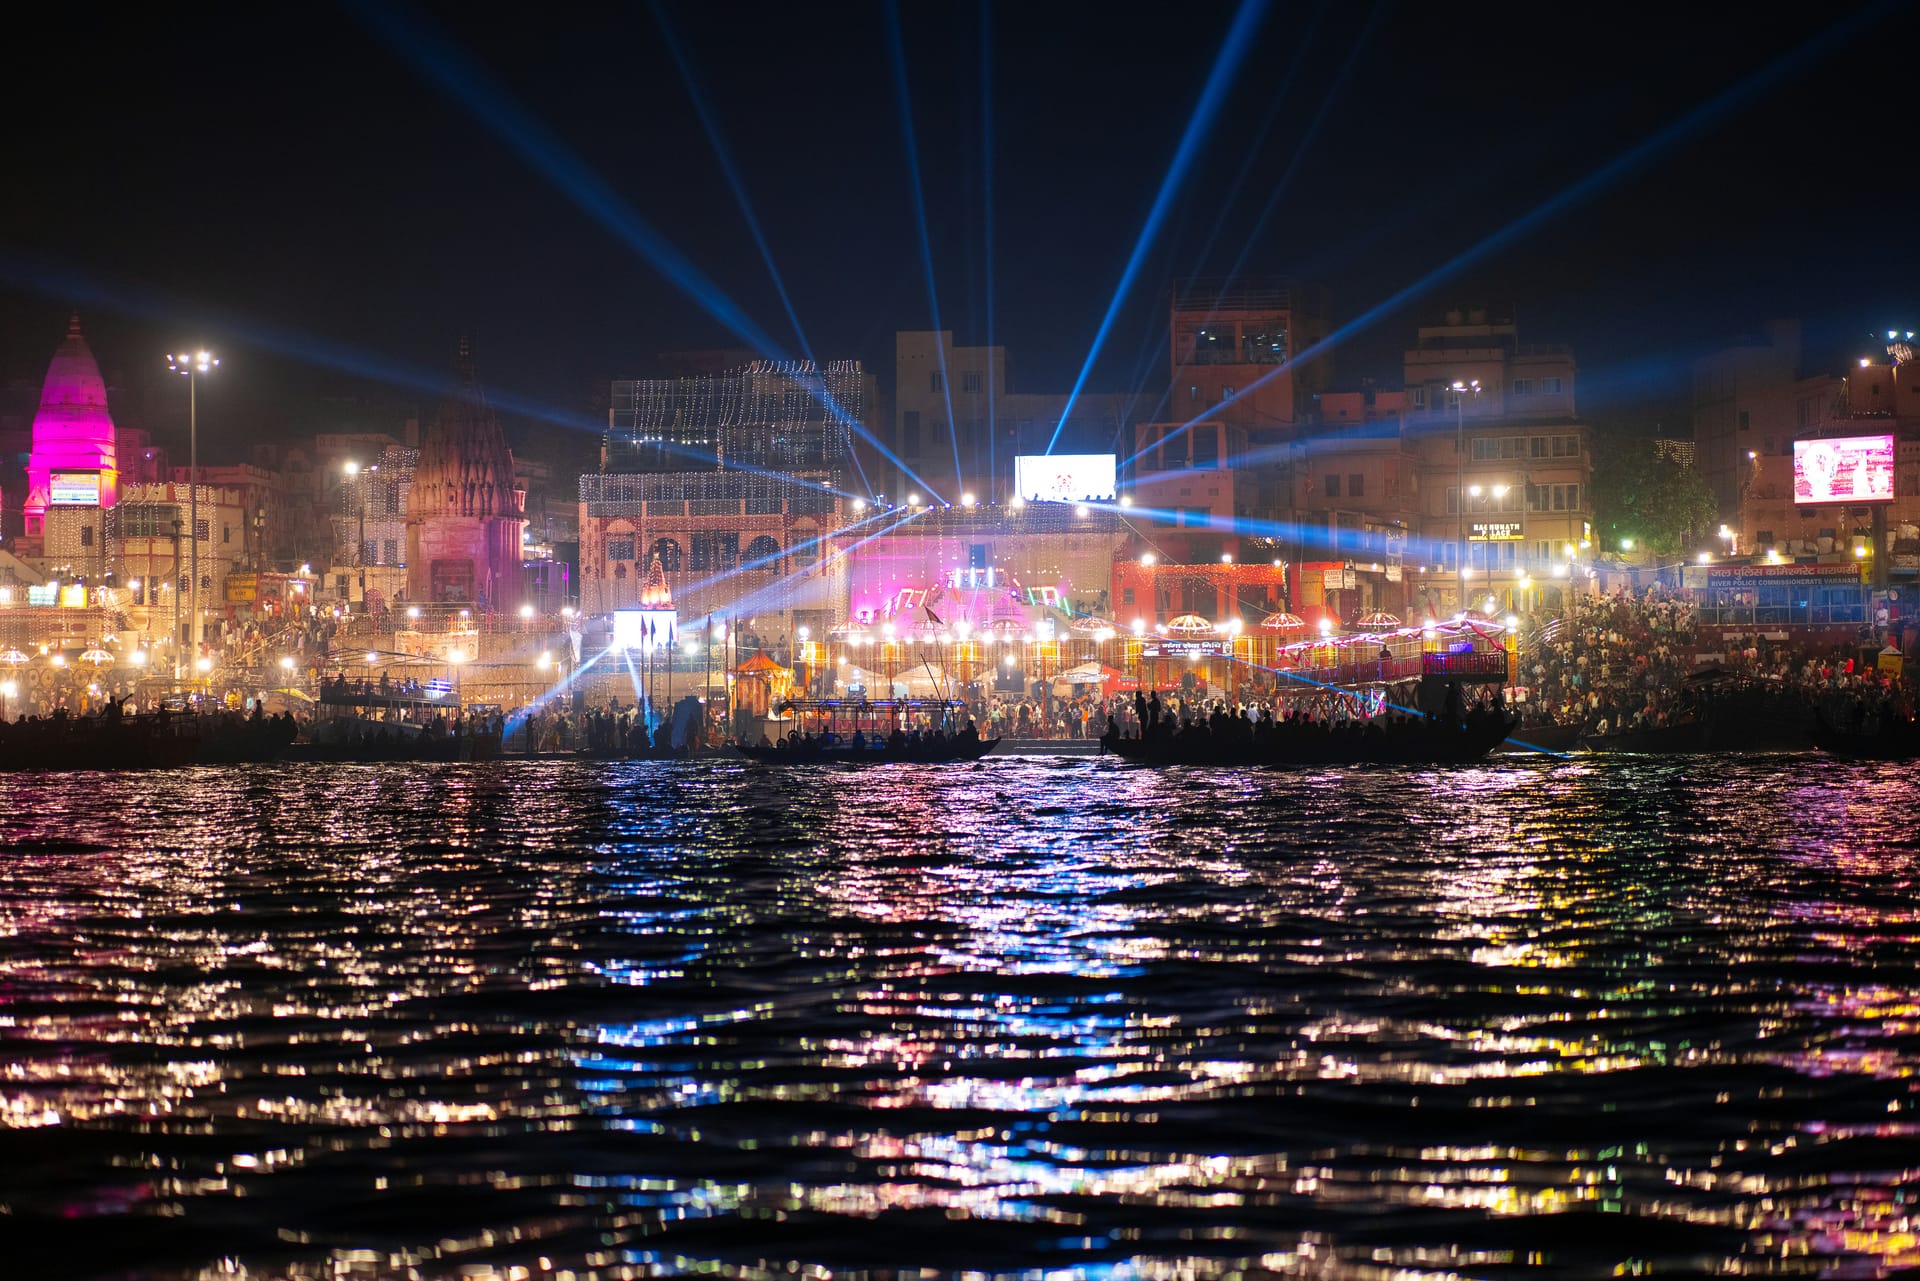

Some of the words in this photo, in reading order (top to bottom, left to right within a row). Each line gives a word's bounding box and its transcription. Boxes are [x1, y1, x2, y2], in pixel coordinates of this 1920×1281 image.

[1711, 568, 1731, 577] जल
[1733, 565, 1763, 580] पुलिस
[1711, 579, 1732, 587] RIVER
[1733, 579, 1756, 587] POLICE
